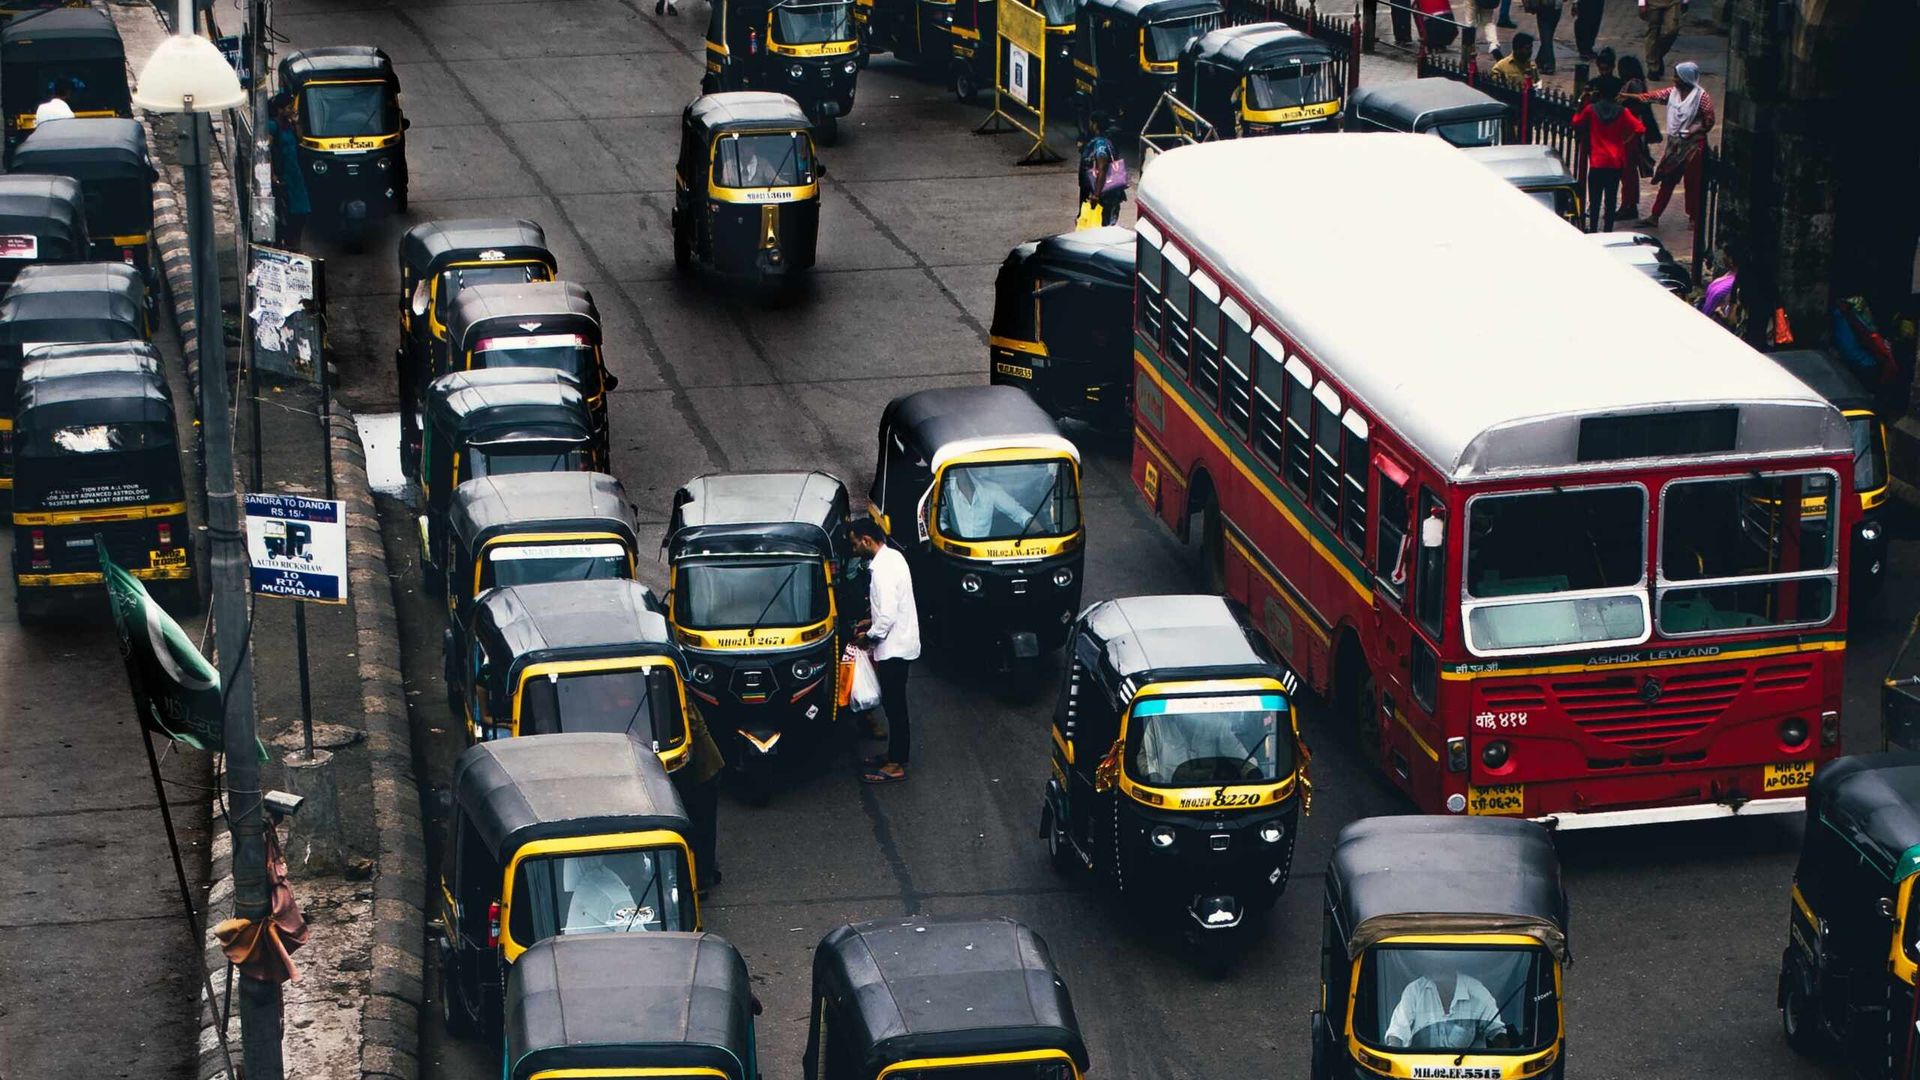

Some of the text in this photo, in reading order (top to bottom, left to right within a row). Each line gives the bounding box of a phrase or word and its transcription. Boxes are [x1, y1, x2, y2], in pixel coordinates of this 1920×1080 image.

[285, 498, 297, 508] TO
[298, 500, 332, 510] DANDA
[271, 508, 287, 517] RS.
[289, 510, 305, 519] 15/-
[281, 561, 323, 572] RICKSHAW
[283, 571, 299, 579] 10
[276, 578, 305, 588] RTA
[261, 584, 321, 598] MUMBAI
[1587, 646, 1720, 665] ASHOK LEYLAND
[1498, 712, 1528, 727] ४१४
